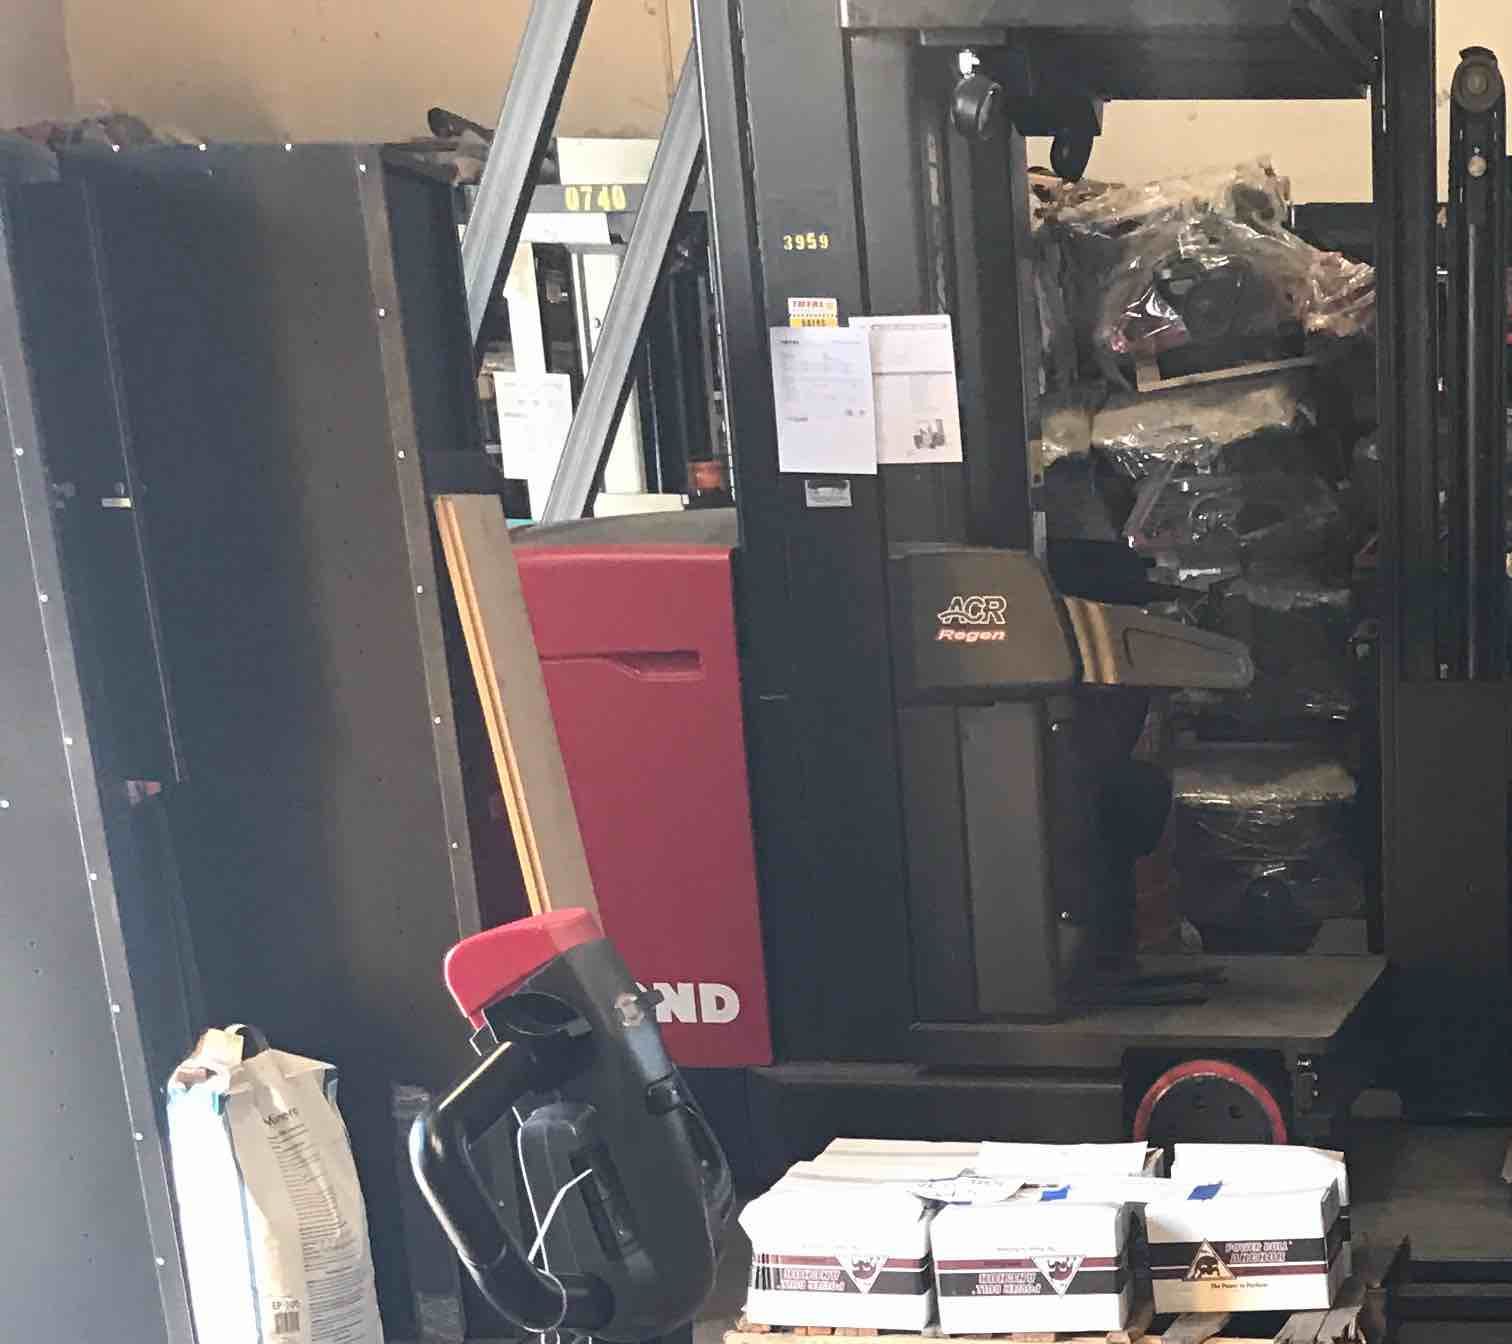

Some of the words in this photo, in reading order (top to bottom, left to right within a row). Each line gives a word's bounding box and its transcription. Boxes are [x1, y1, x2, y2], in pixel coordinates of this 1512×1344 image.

[784, 232, 830, 250] 3959
[937, 595, 1007, 624] ACR
[937, 629, 1006, 642] Regen
[651, 981, 740, 1024] ND
